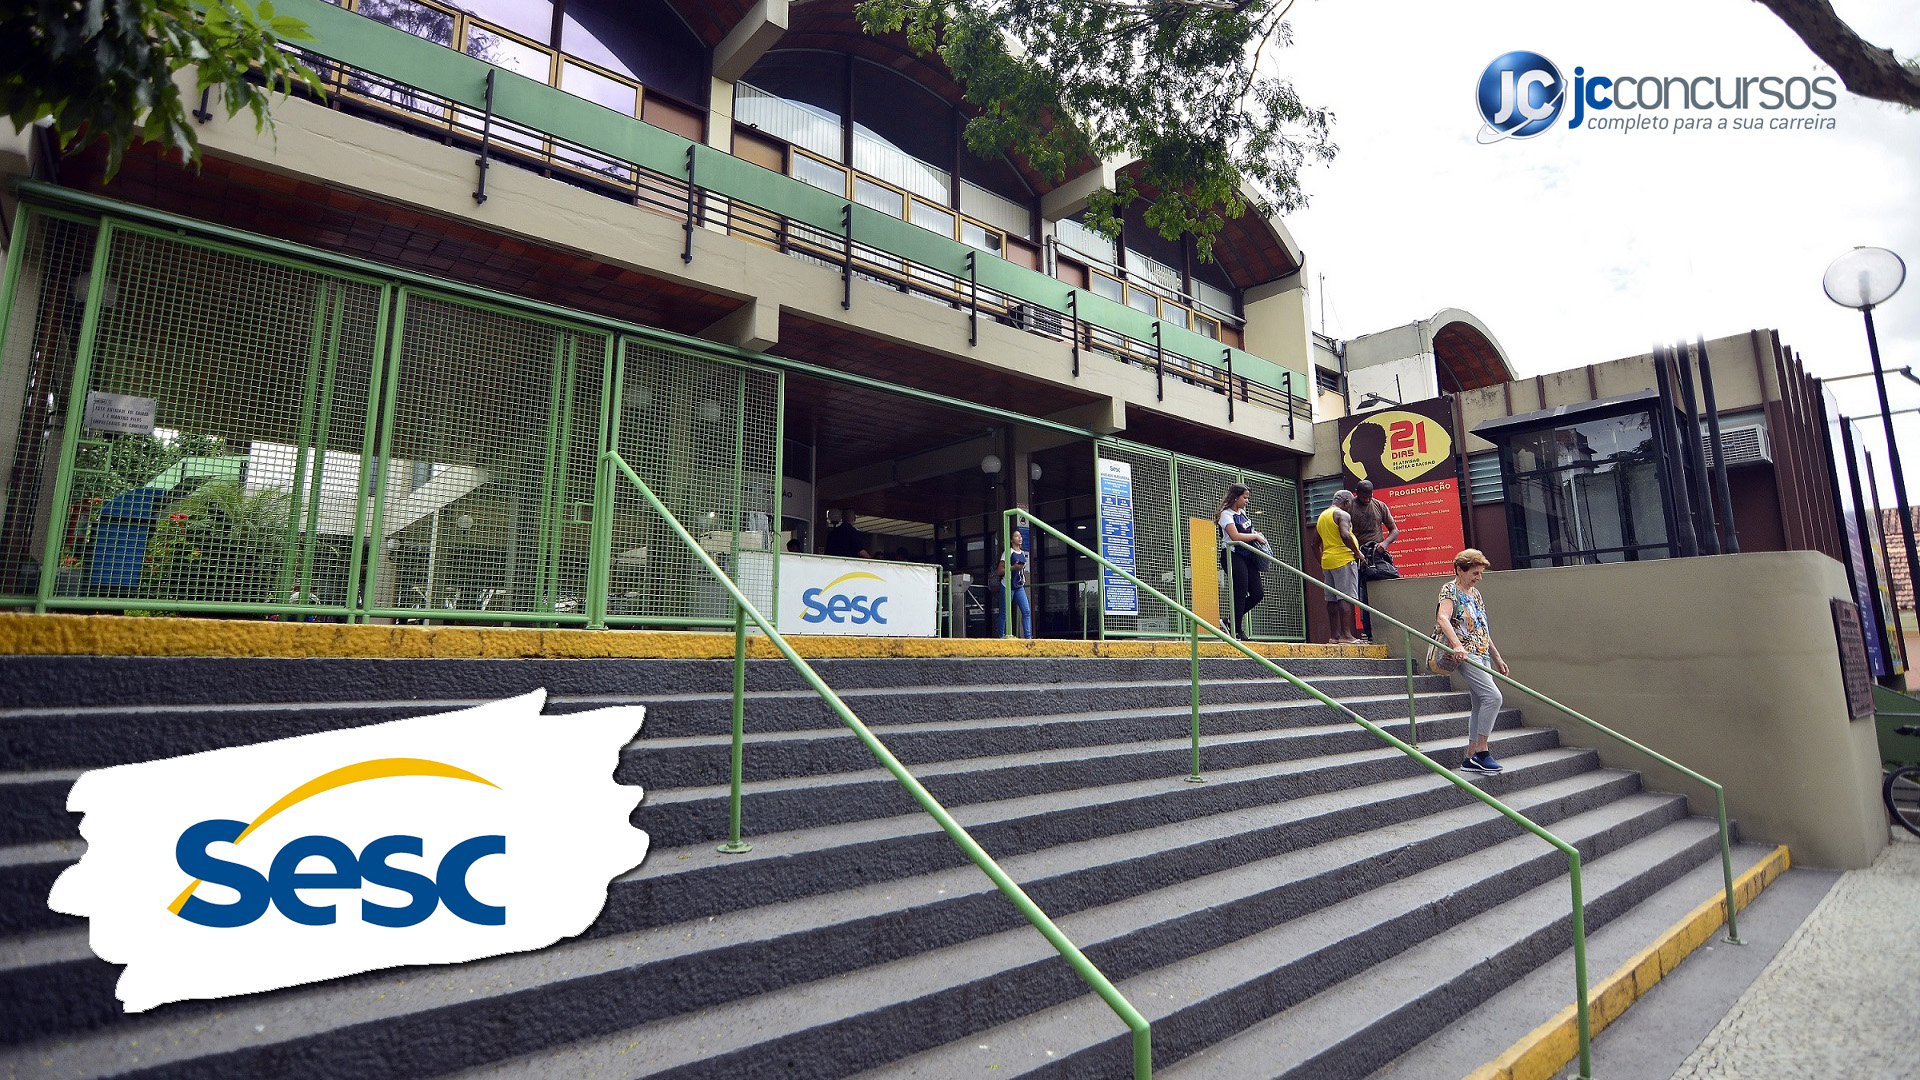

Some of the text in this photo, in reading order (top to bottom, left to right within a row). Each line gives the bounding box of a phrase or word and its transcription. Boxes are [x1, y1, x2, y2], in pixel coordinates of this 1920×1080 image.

[1389, 420, 1427, 454] 21
[1391, 449, 1415, 460] DIAS
[1389, 481, 1451, 497] PROGRAMAÇÃO
[802, 587, 888, 625] Sesc
